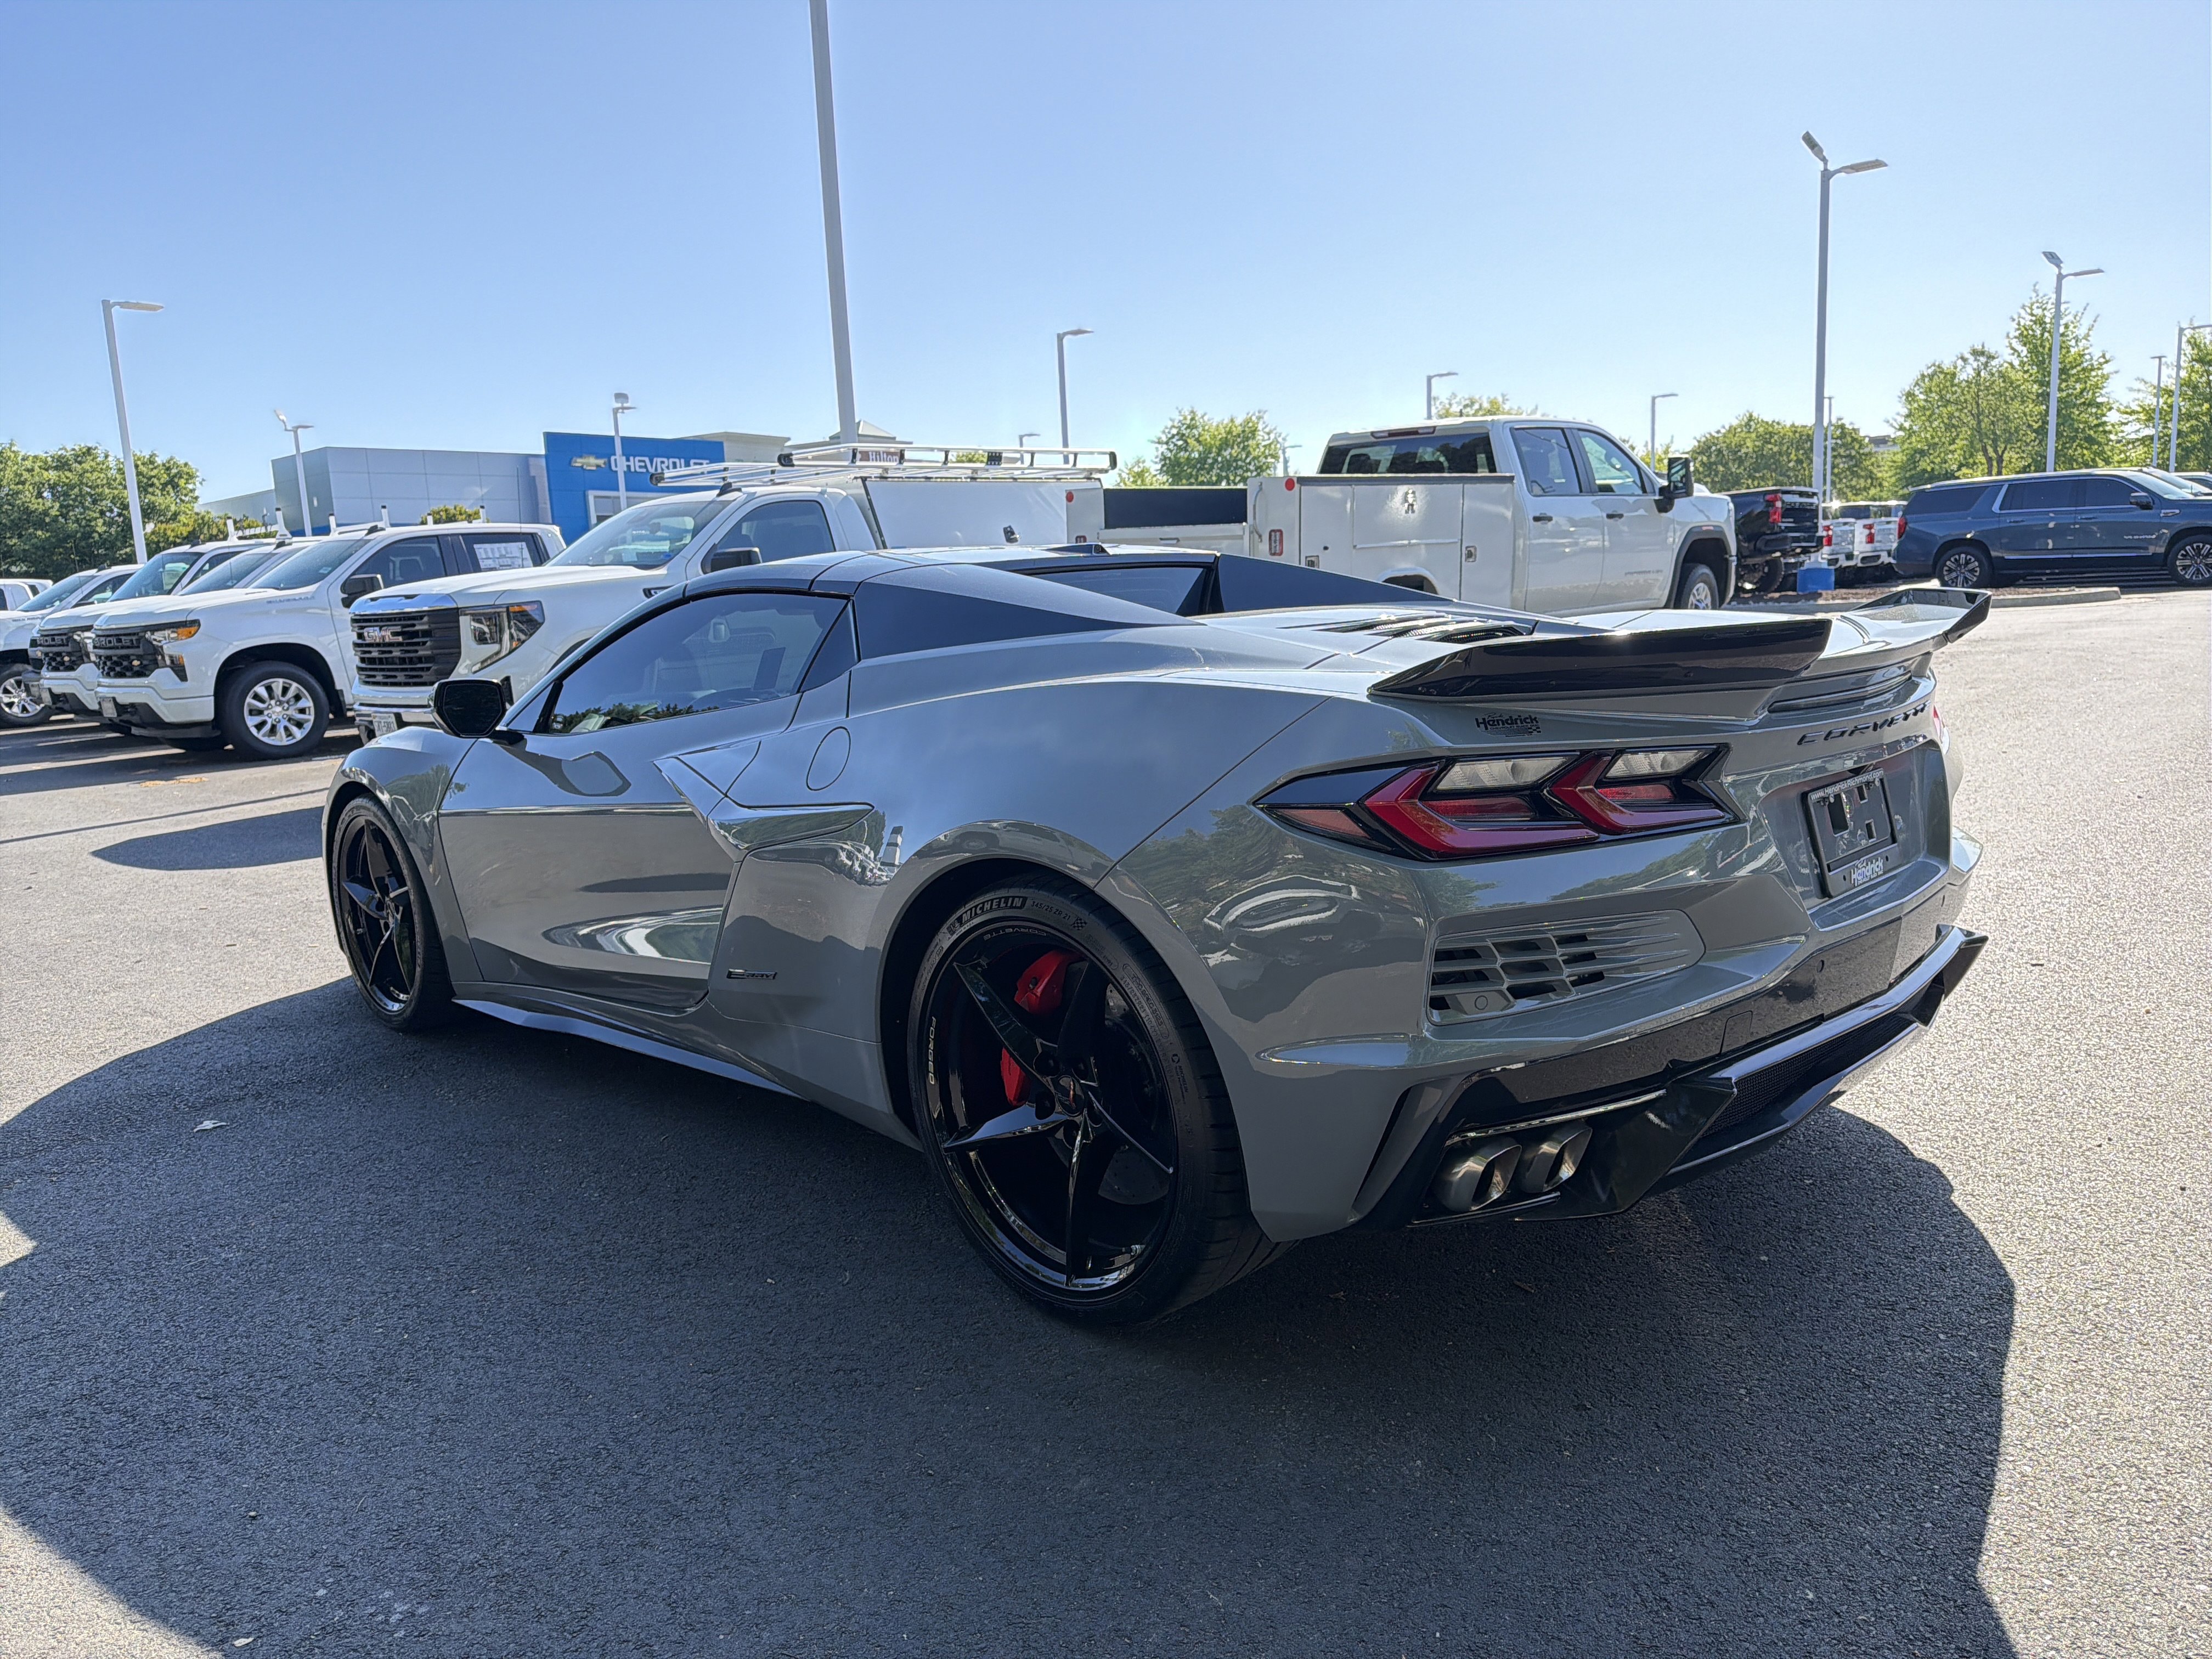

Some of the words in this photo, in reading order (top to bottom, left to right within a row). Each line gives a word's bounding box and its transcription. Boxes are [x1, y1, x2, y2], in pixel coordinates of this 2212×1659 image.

[868, 450, 899, 463] Hilton
[364, 625, 403, 643] GMC
[1475, 714, 1539, 731] Hendrick
[1810, 770, 1884, 801] www.HendrickRichmond.com
[1850, 856, 1883, 887] Hendrick
[961, 897, 1023, 923] MICHELIN
[1031, 900, 1054, 913] 345/25
[1053, 908, 1063, 917] ZR
[1063, 913, 1071, 921] 21
[983, 928, 1047, 941] CORVETTE
[1139, 989, 1155, 1008] SPEC
[928, 1016, 936, 1085] FORGED
[1177, 1065, 1190, 1093] MICHELIN
